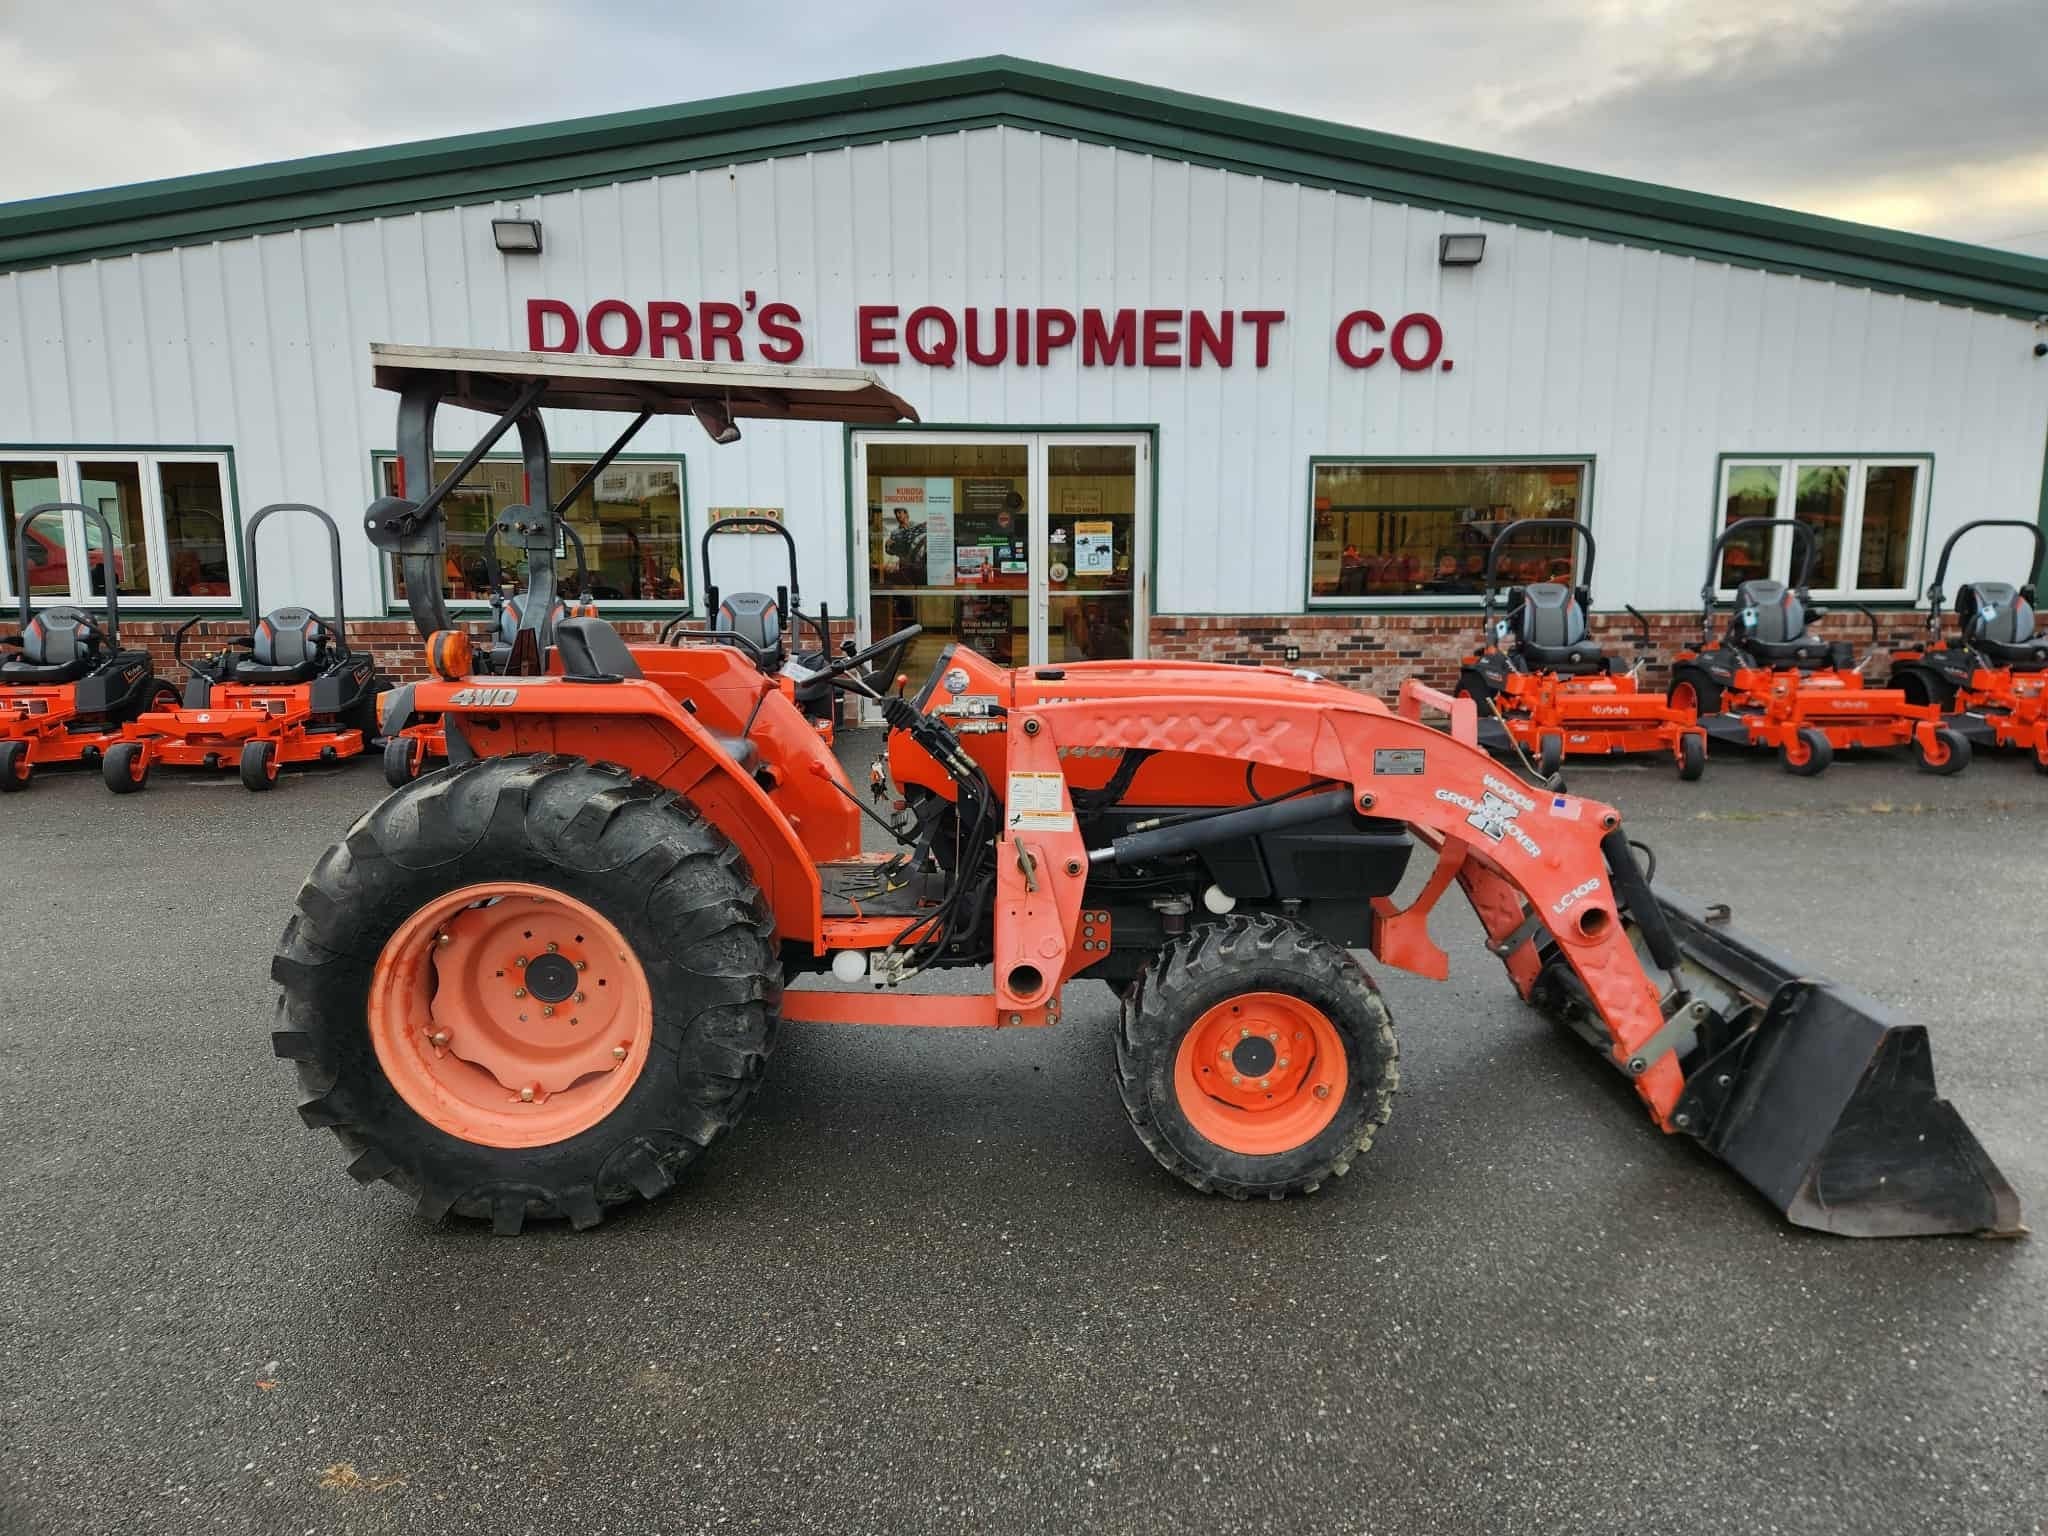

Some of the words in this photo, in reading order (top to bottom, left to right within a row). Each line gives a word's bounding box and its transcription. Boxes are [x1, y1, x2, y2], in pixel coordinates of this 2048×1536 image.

[526, 290, 804, 363] DORR'S
[858, 305, 1286, 368] EQUIPMENT
[1335, 309, 1454, 371] CO.
[447, 688, 519, 706] 4WD
[1592, 704, 1630, 715] Kubota
[1483, 773, 1536, 812] WOODS
[1551, 878, 1601, 915] LC108
